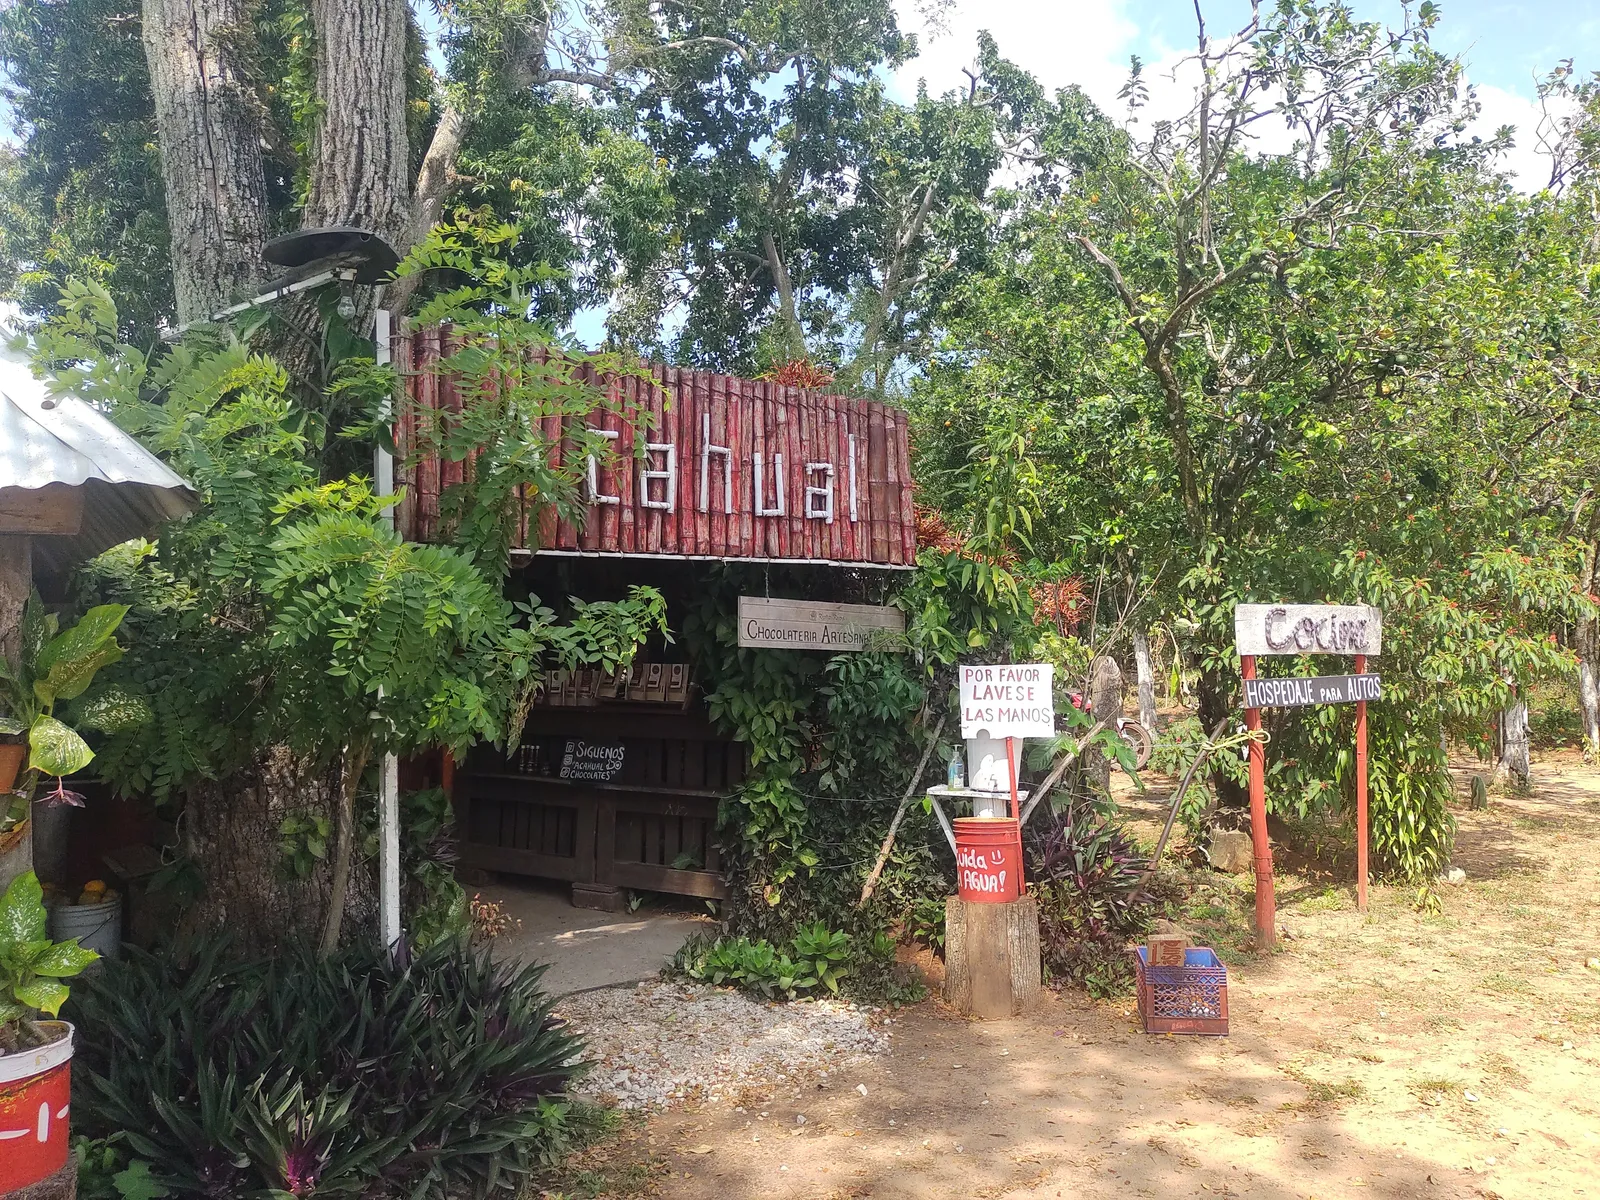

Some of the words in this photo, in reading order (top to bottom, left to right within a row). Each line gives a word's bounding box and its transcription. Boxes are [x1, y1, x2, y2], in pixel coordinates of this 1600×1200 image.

[965, 668, 993, 682] POR
[999, 668, 1040, 682] FAVOR
[973, 685, 1034, 701] LAVESE
[1246, 680, 1315, 707] HOSPEDAJE
[1320, 688, 1343, 702] PARA
[1347, 676, 1381, 701] AUTOS
[965, 707, 994, 723] LAS
[998, 708, 1051, 723] MANOS
[576, 742, 625, 760] SIGUENOS
[956, 847, 988, 870] uida
[963, 869, 1007, 893] AGUA!
[1159, 940, 1182, 966] asura
